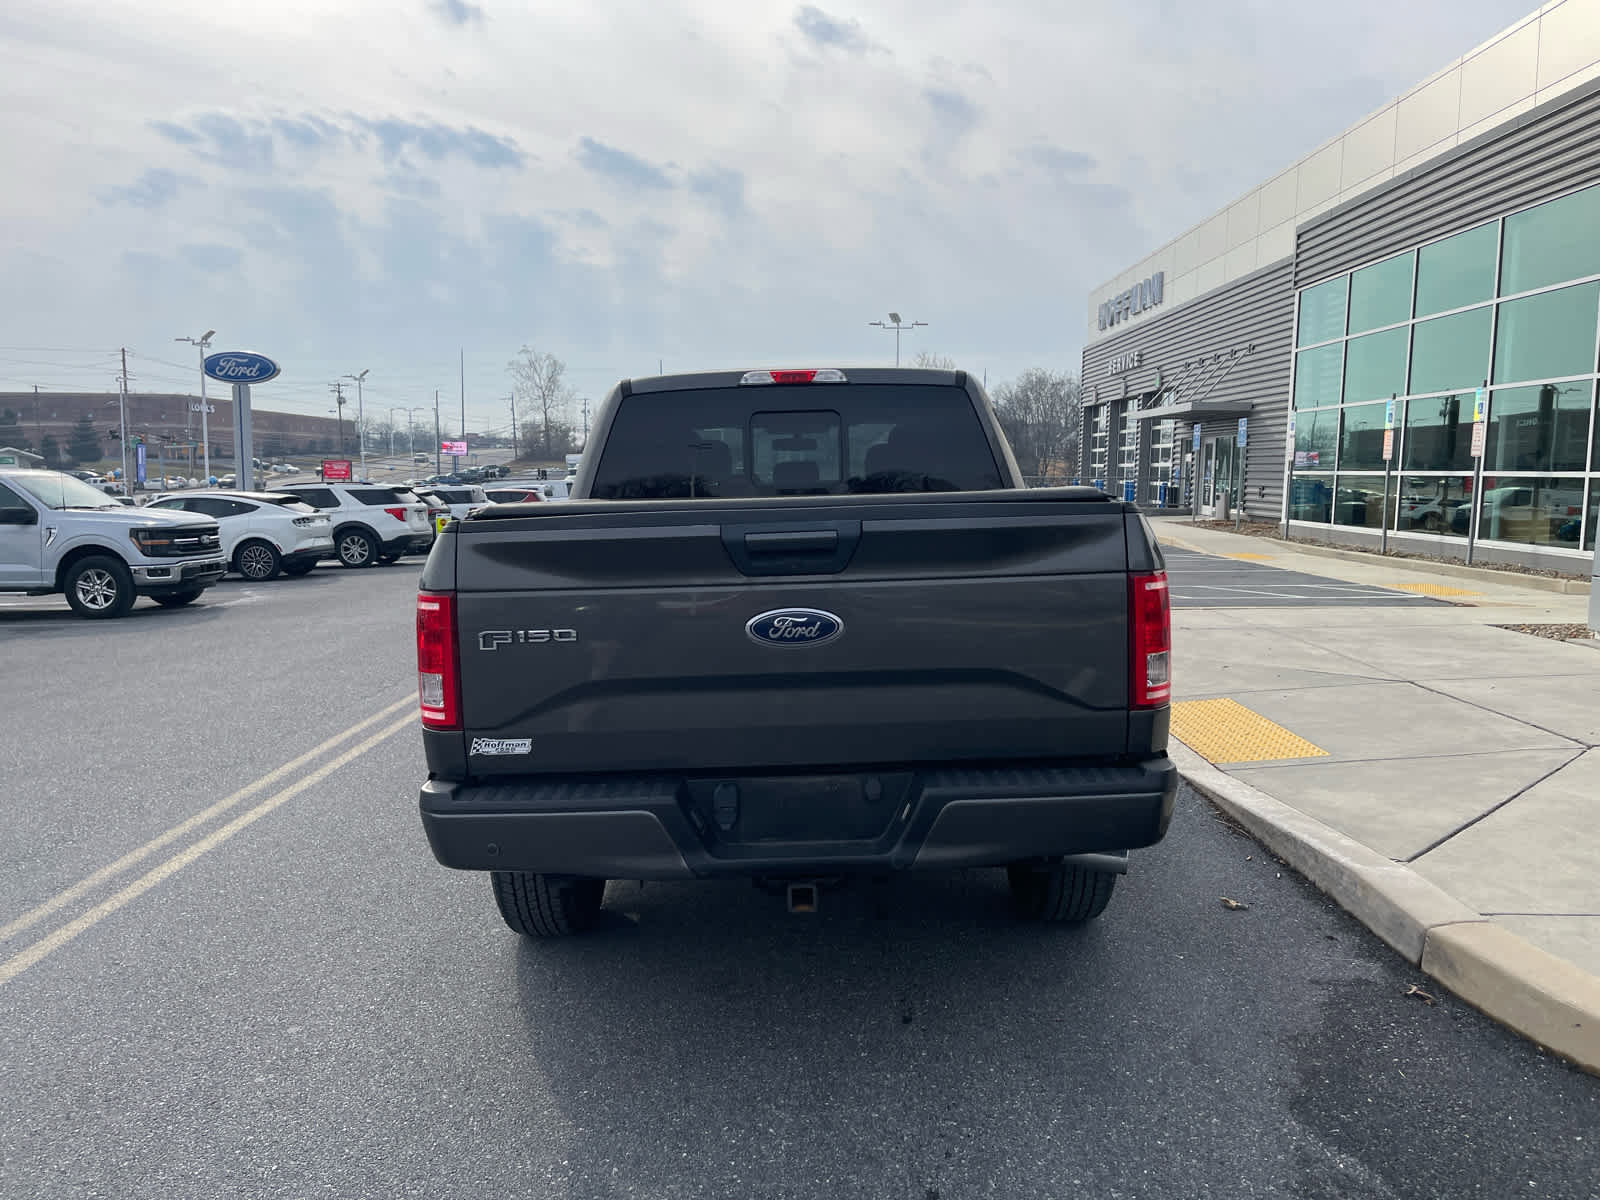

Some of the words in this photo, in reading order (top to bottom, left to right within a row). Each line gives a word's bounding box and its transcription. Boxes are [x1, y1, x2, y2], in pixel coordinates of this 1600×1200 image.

[215, 357, 260, 377] Ford
[1108, 351, 1141, 375] SERVICE
[768, 616, 821, 639] Ford
[483, 740, 528, 749] Hoffman
